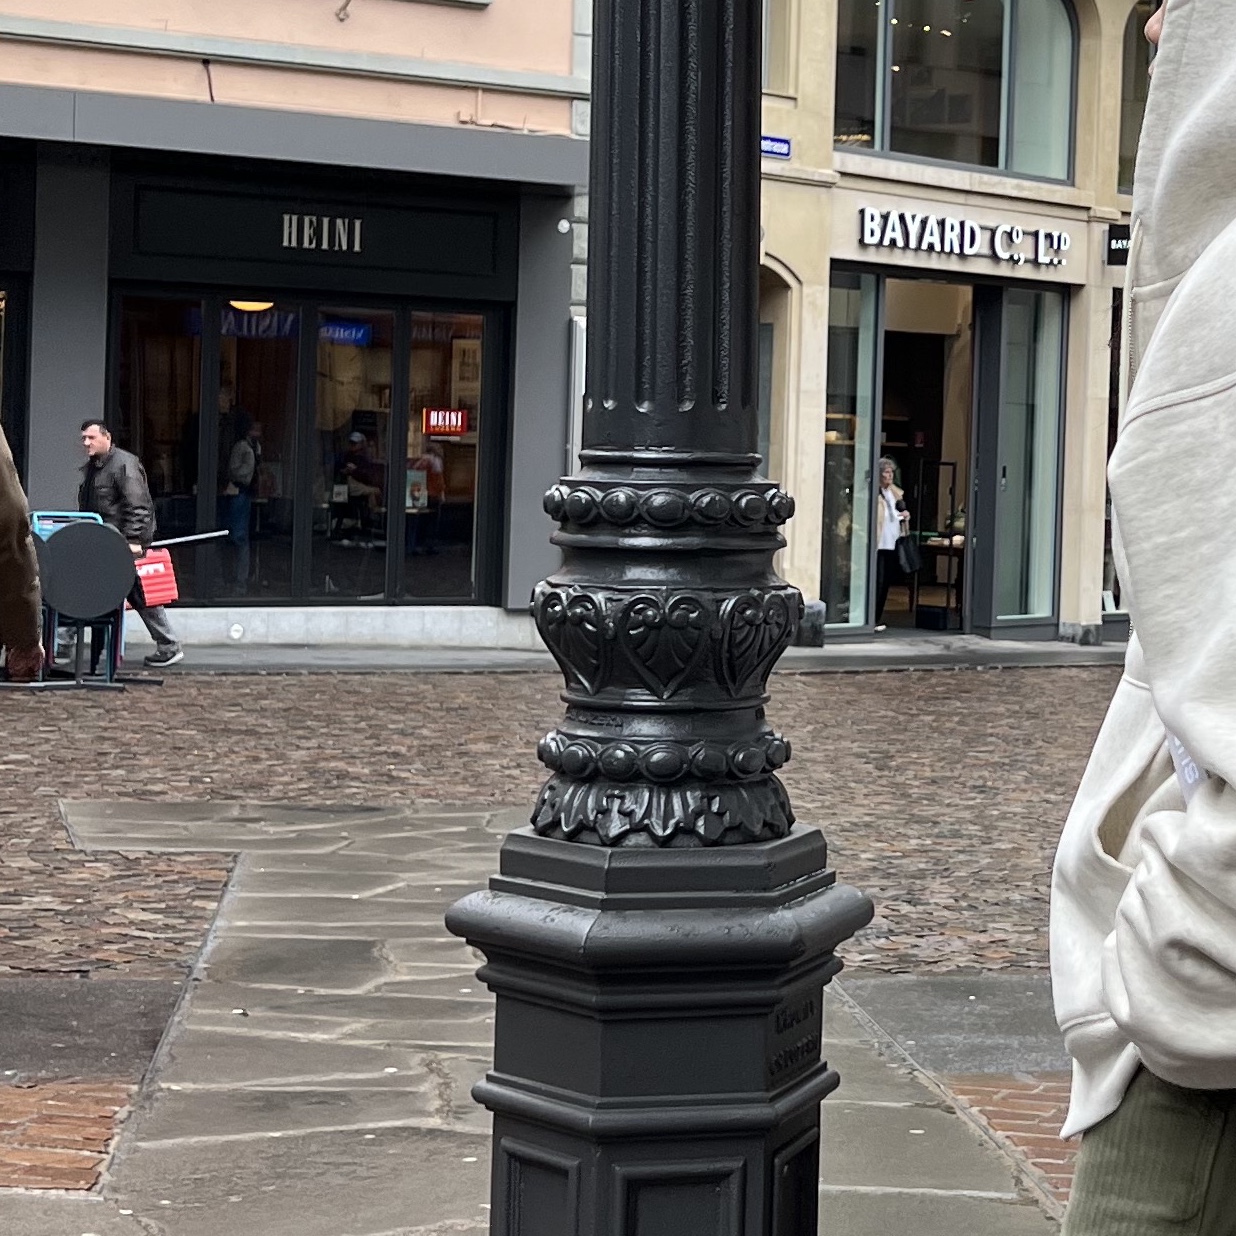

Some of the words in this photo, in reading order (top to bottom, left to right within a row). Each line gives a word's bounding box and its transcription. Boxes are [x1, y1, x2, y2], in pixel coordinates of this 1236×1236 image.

[282, 213, 362, 253] HEINI
[863, 206, 981, 255] BAYARD
[430, 410, 462, 426] HEINI
